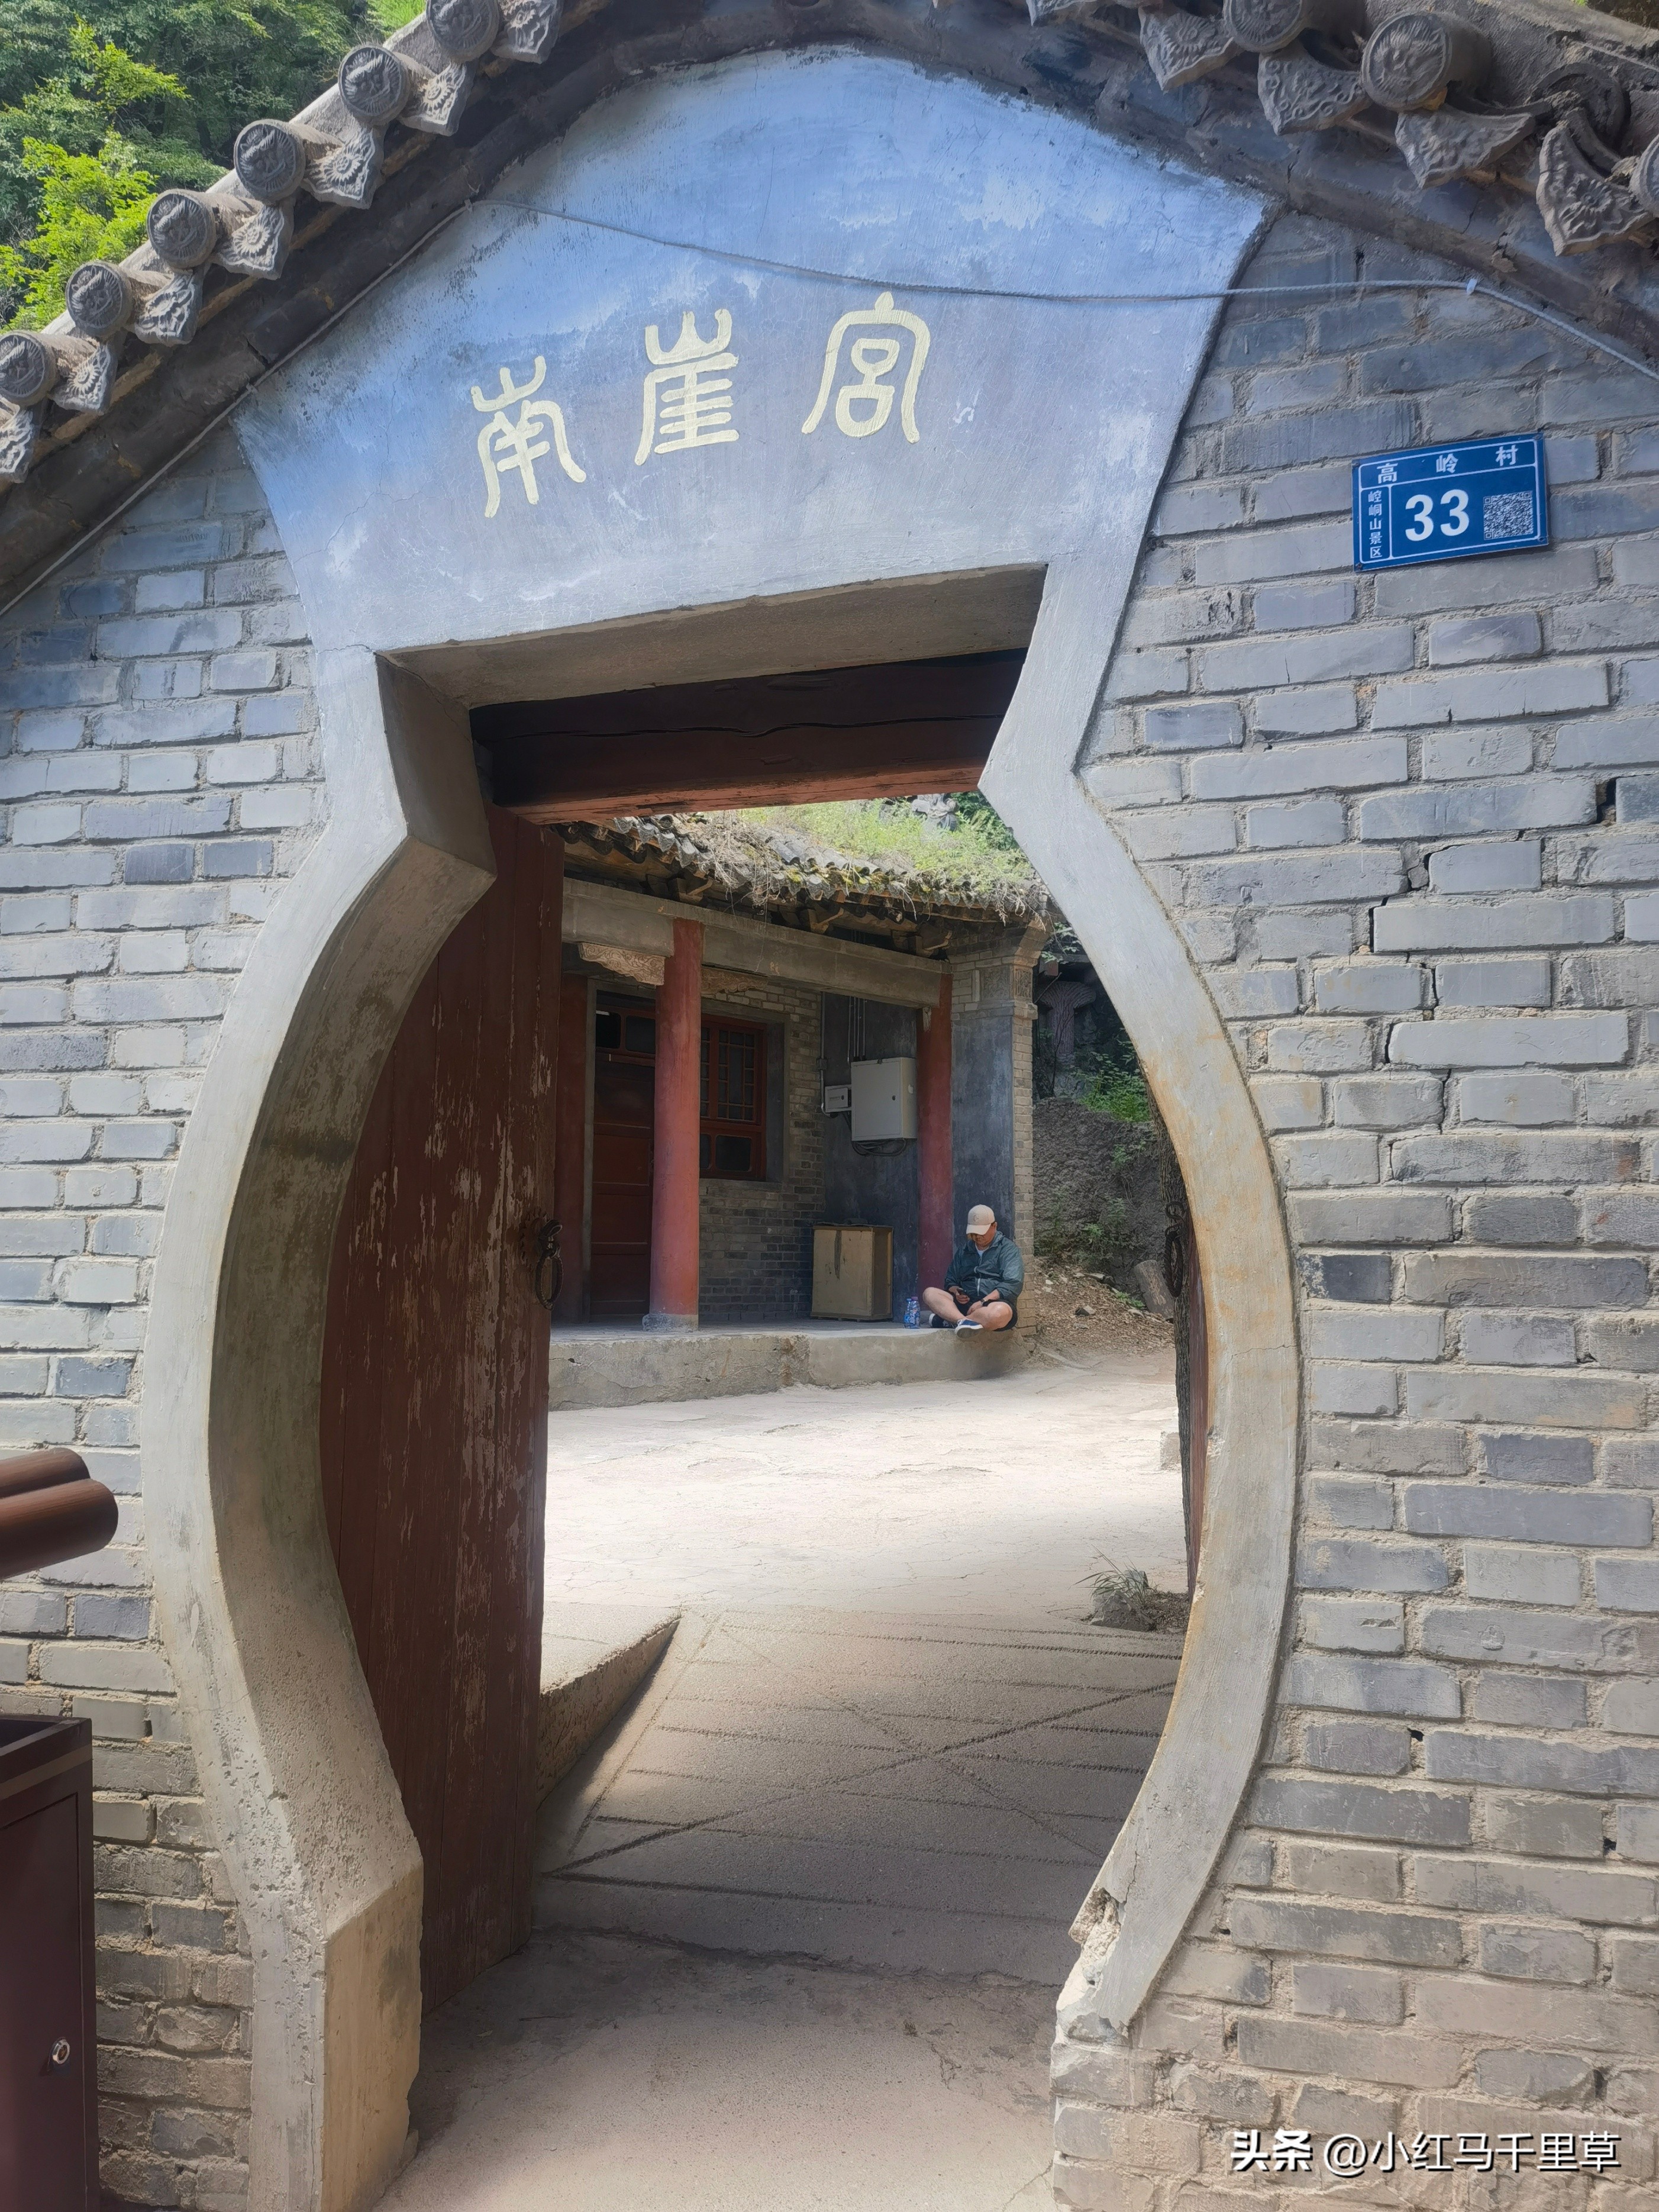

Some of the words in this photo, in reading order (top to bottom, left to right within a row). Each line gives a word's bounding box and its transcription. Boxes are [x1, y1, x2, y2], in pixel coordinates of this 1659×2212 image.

[472, 291, 931, 518] 南崖宫
[1377, 444, 1518, 484] 高岭村
[1368, 490, 1383, 559] 崆峒山景区
[1405, 489, 1470, 542] 33
